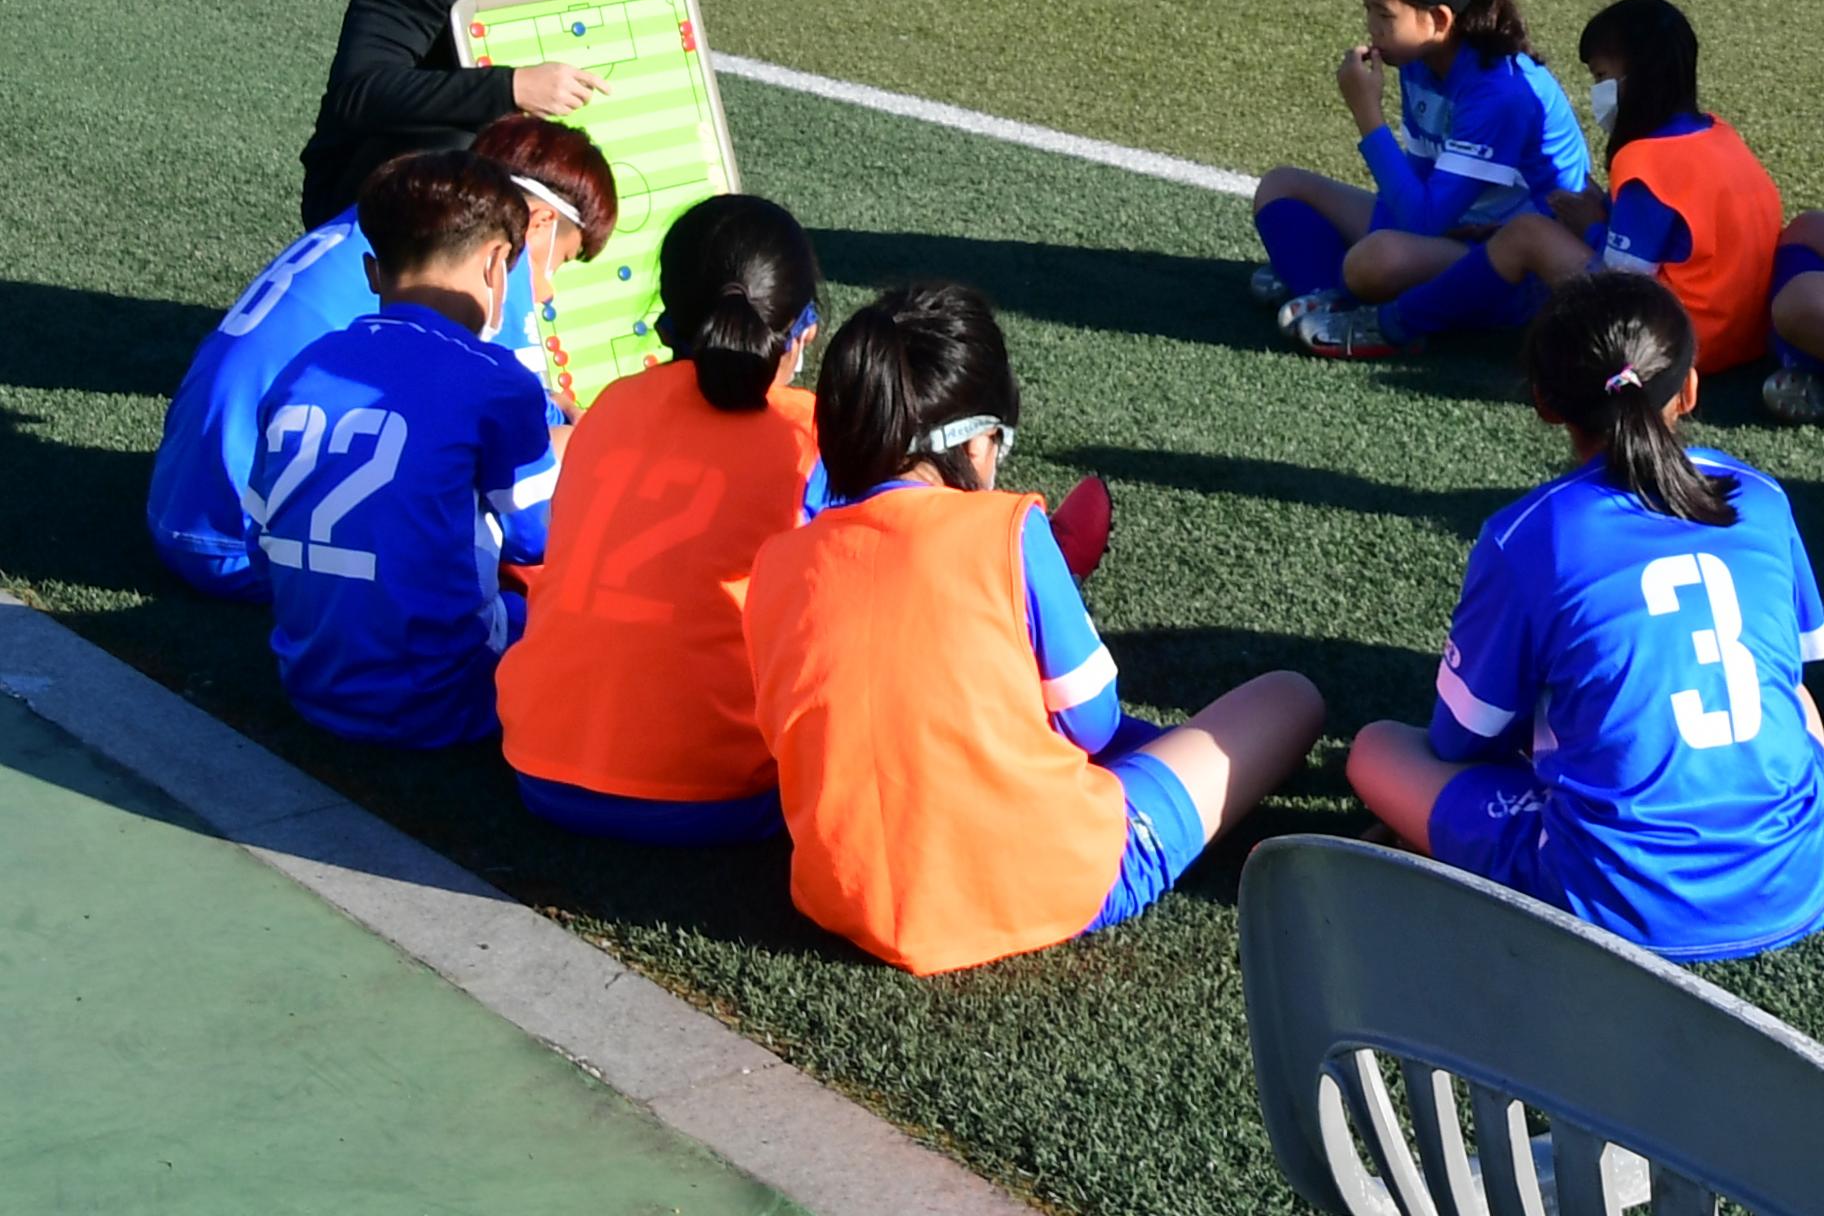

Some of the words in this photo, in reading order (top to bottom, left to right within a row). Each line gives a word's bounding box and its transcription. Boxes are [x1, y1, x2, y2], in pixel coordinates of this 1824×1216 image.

[242, 404, 408, 581] 22
[558, 448, 727, 623] 12
[1641, 552, 1763, 750] 3
